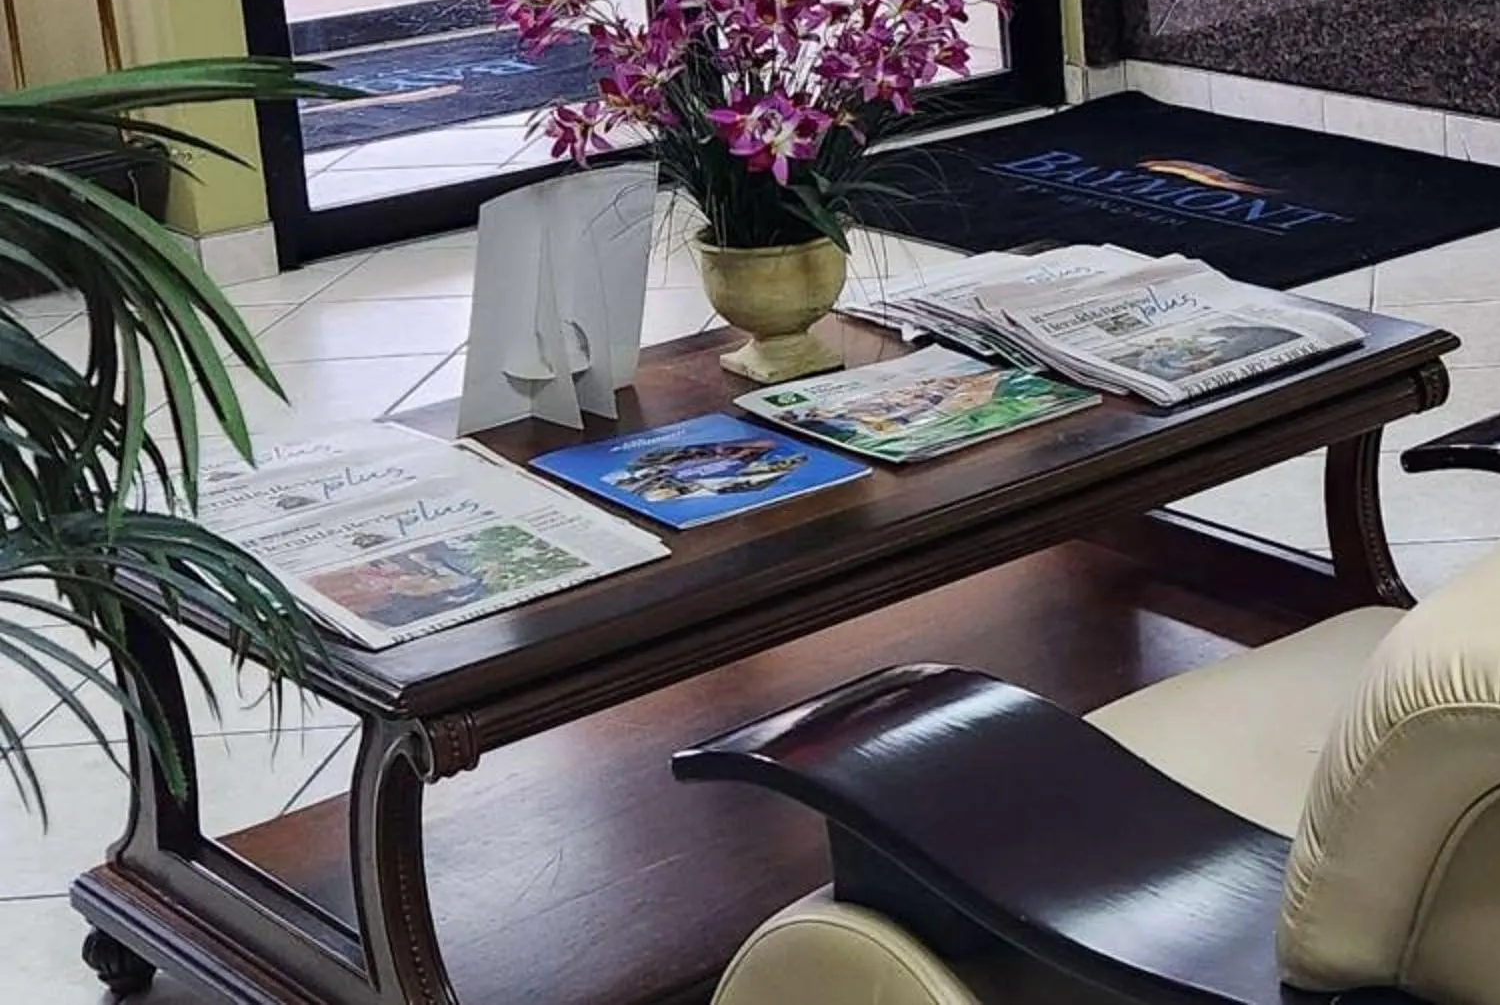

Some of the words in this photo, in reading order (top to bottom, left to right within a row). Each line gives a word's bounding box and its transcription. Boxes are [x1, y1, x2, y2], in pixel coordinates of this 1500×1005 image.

[994, 150, 1348, 229] BAYMONT
[1136, 284, 1198, 327] plus
[323, 466, 404, 500] plus
[397, 499, 479, 536] plus
